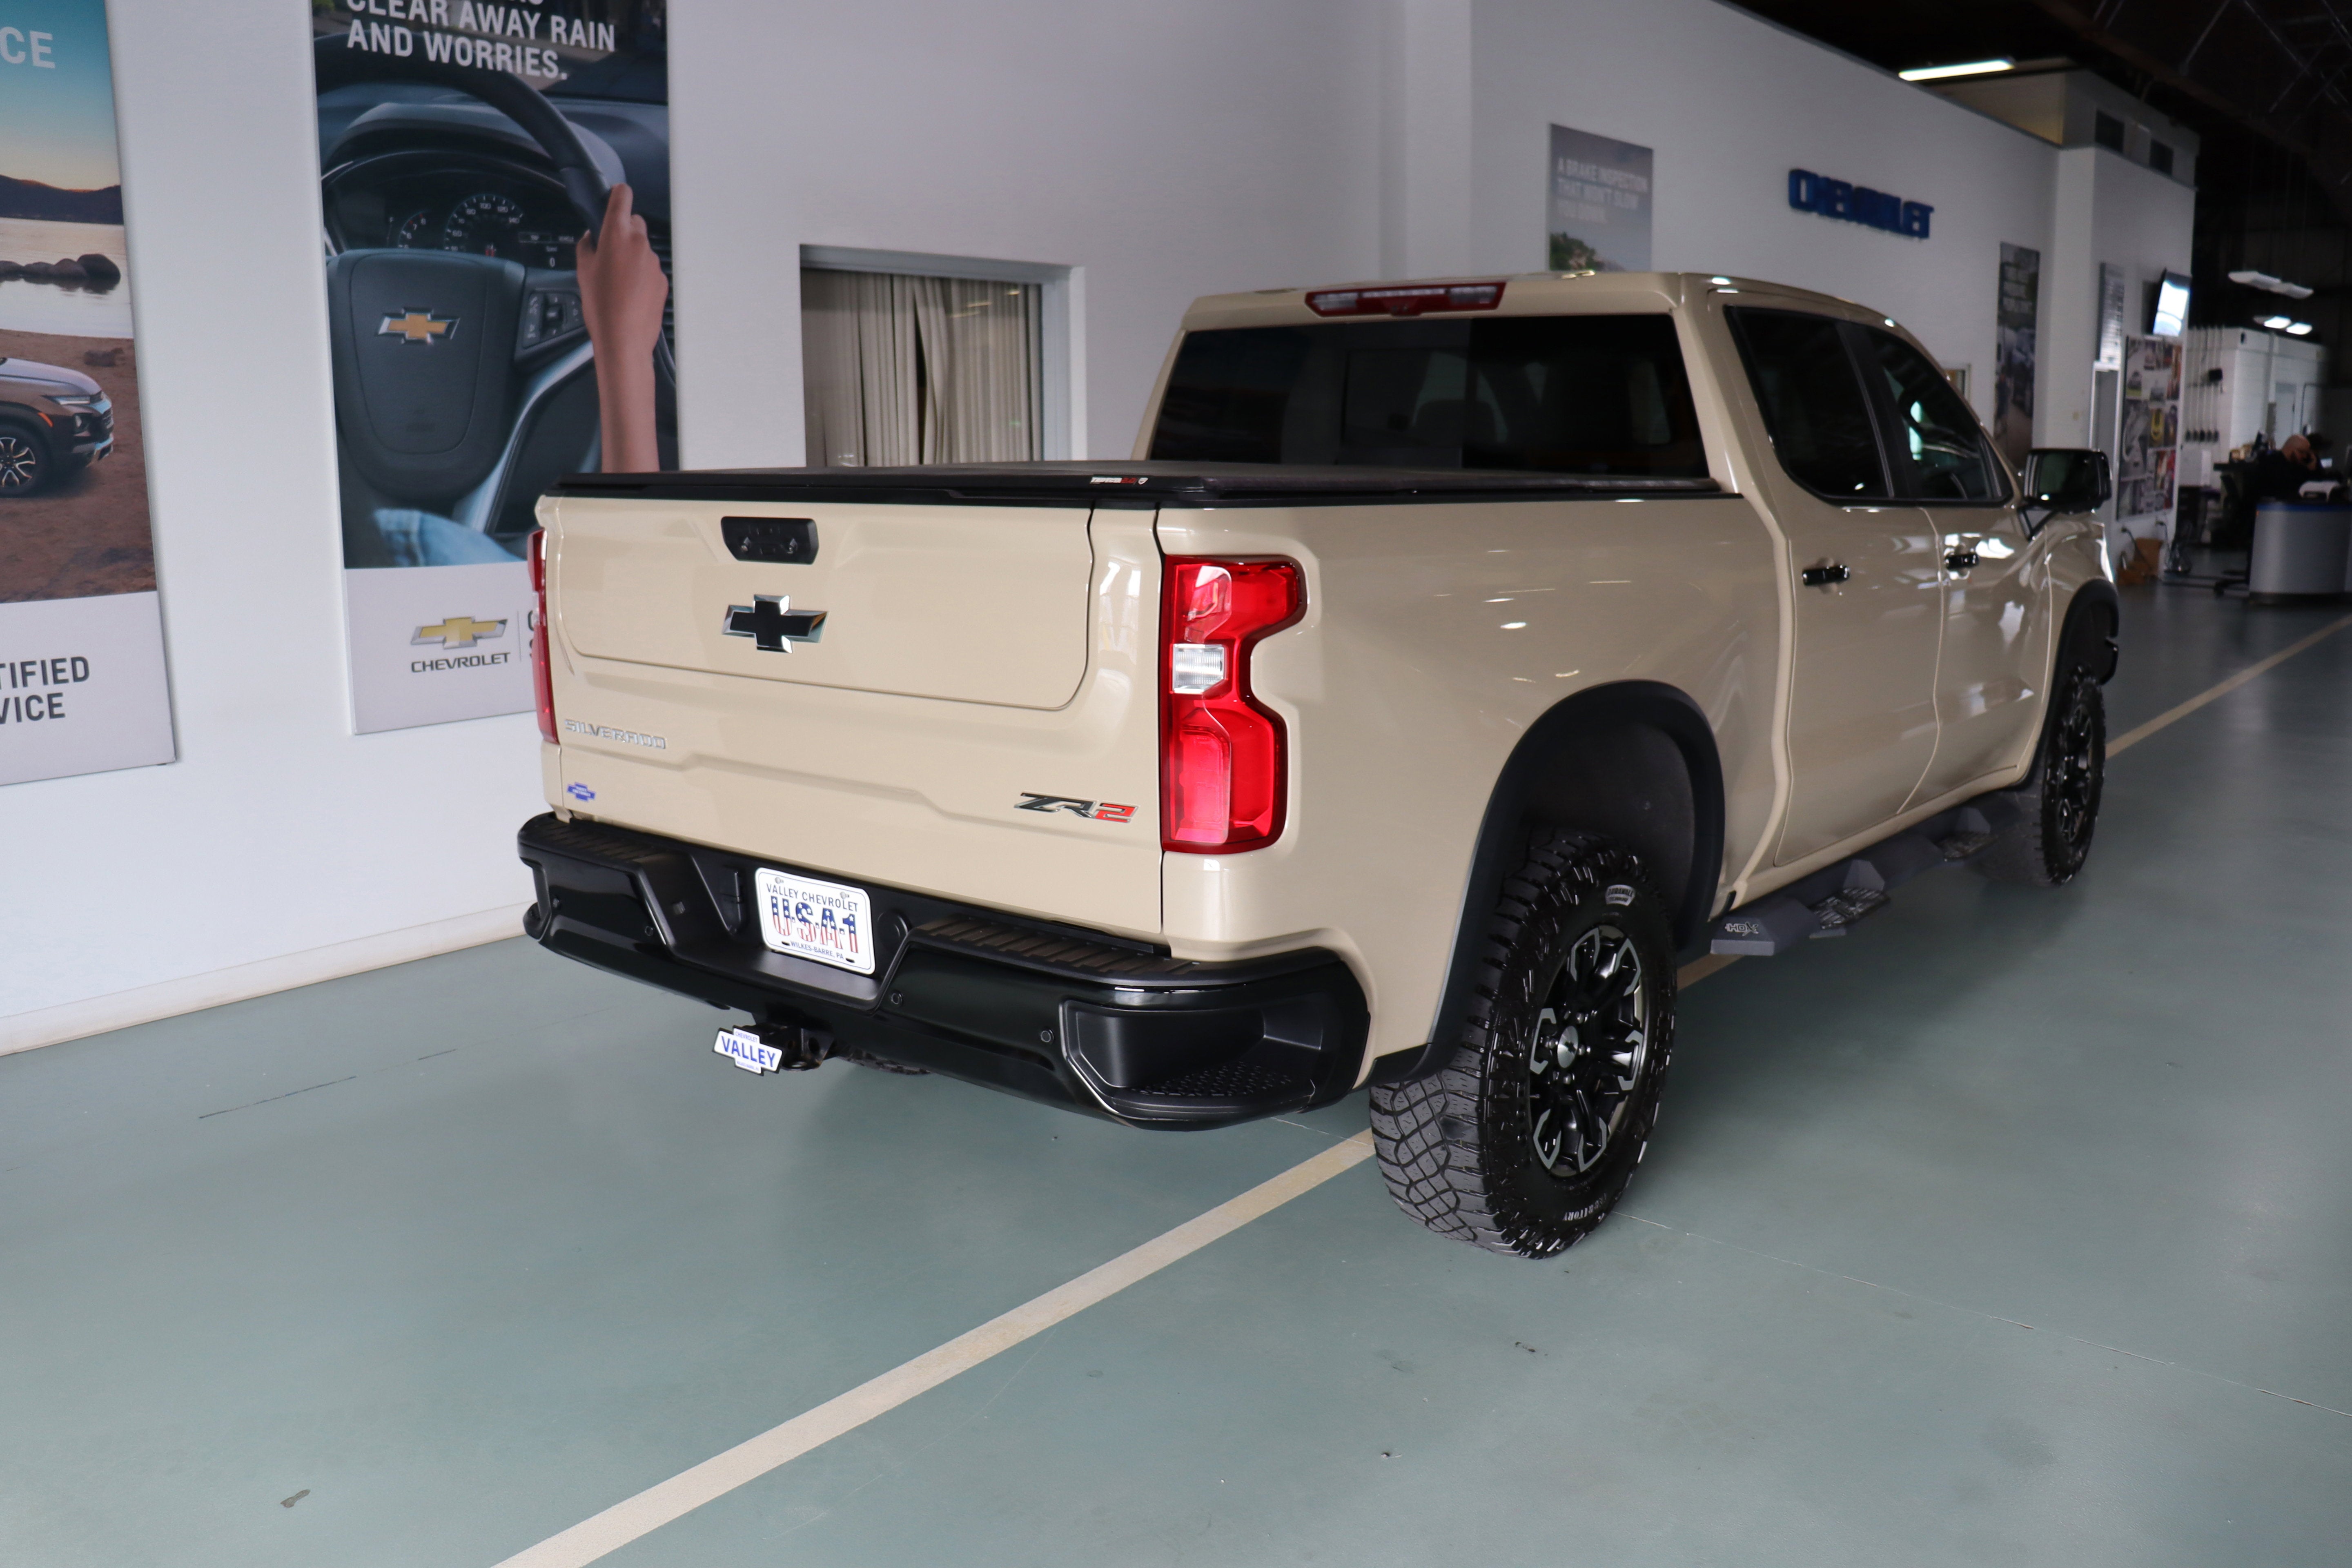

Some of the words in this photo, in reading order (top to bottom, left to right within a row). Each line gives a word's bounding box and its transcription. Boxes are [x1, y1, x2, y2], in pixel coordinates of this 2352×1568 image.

[459, 1, 540, 40] AWAY
[550, 15, 615, 52] RAIN
[347, 19, 412, 57] AND
[423, 31, 568, 80] WORRIES.
[411, 652, 511, 673] CHEVROLET
[564, 719, 667, 749] SILVERADO
[1013, 792, 1139, 823] ZR2
[766, 882, 799, 899] VALLEY
[802, 891, 858, 912] CHEVROLET
[791, 940, 835, 959] WILKES-BARRE,
[722, 1036, 775, 1067] VALLEY
[735, 1031, 757, 1043] CHEVROLET
